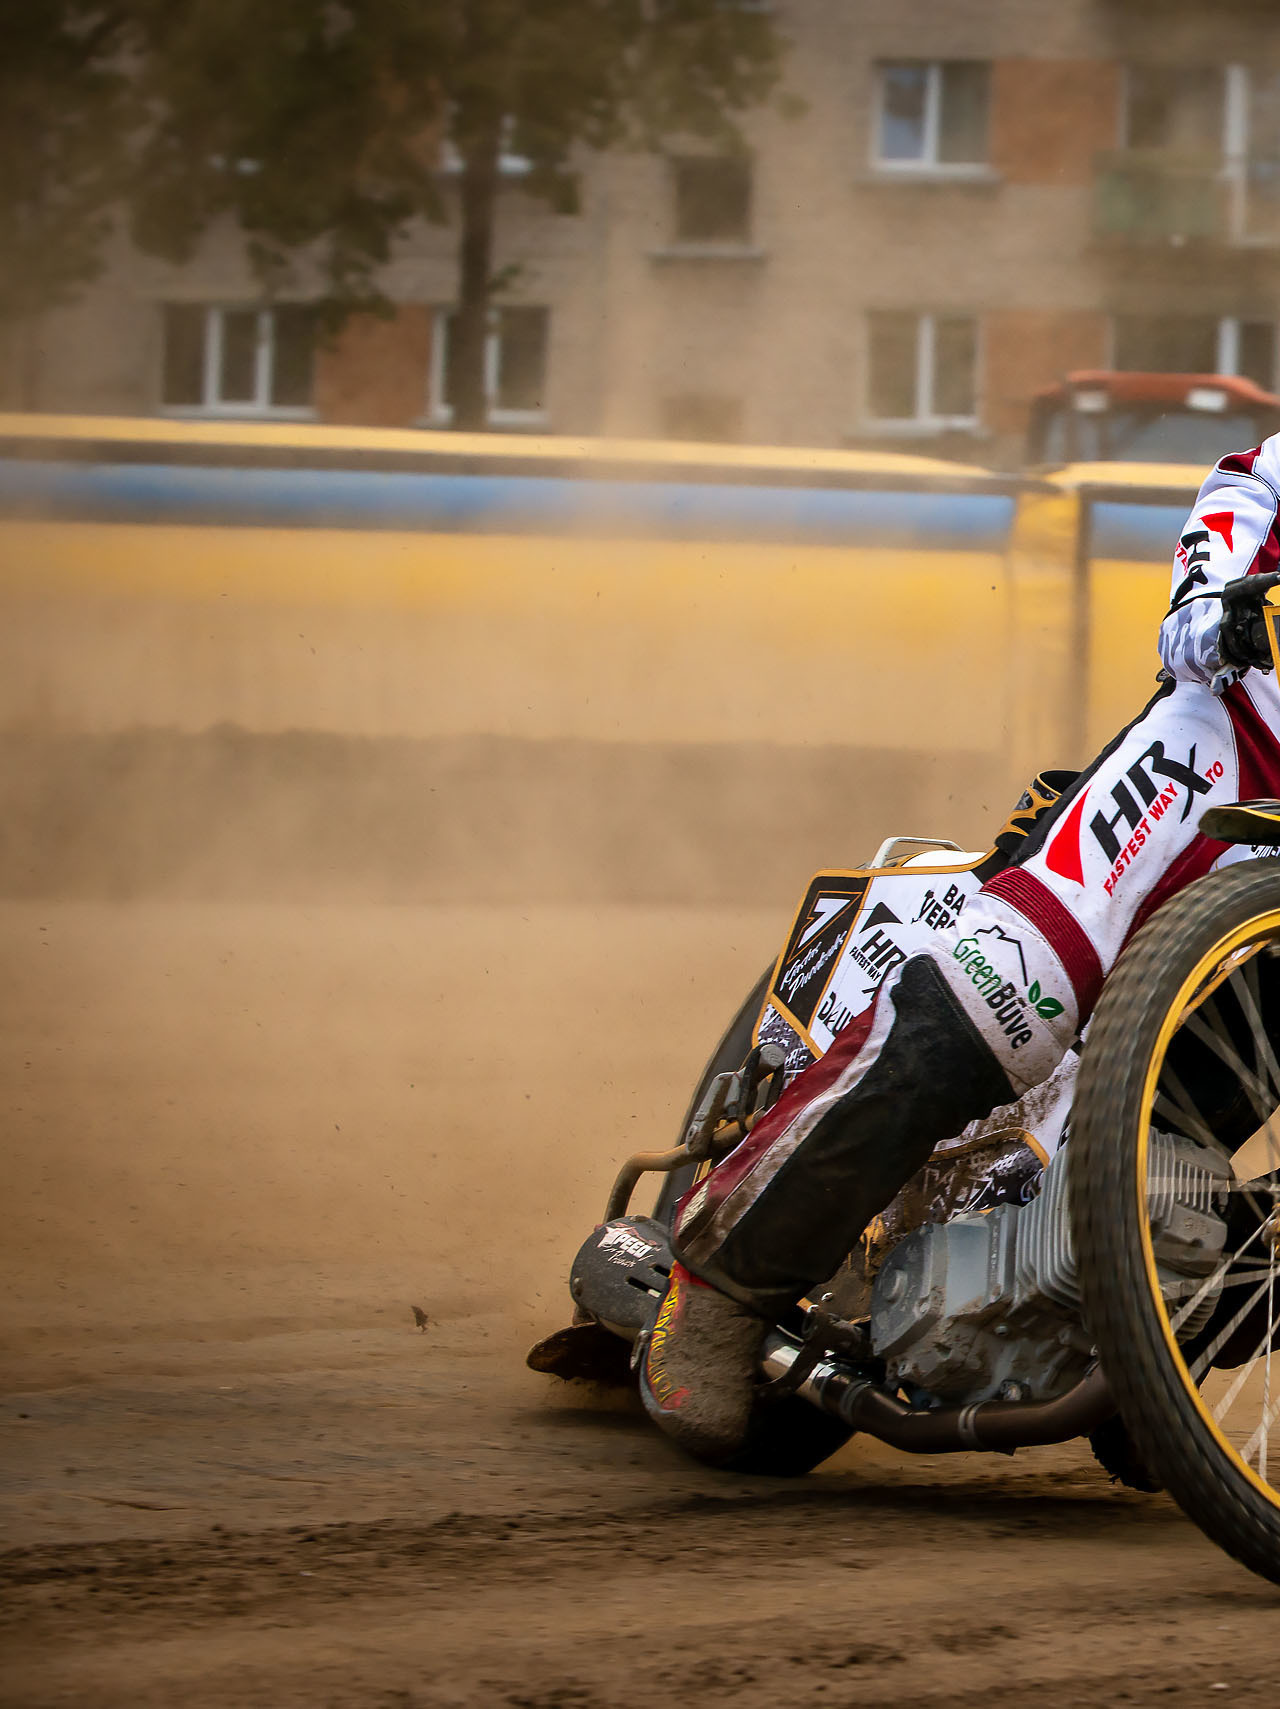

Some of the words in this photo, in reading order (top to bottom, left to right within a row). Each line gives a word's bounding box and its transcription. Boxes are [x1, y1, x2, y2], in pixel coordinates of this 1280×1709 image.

[1103, 818, 1152, 898] FASTEST
[1148, 781, 1179, 822] WAY
[1205, 760, 1224, 784] TO
[798, 898, 851, 949] 7
[848, 946, 871, 971] FASTEST
[866, 965, 882, 982] WAY
